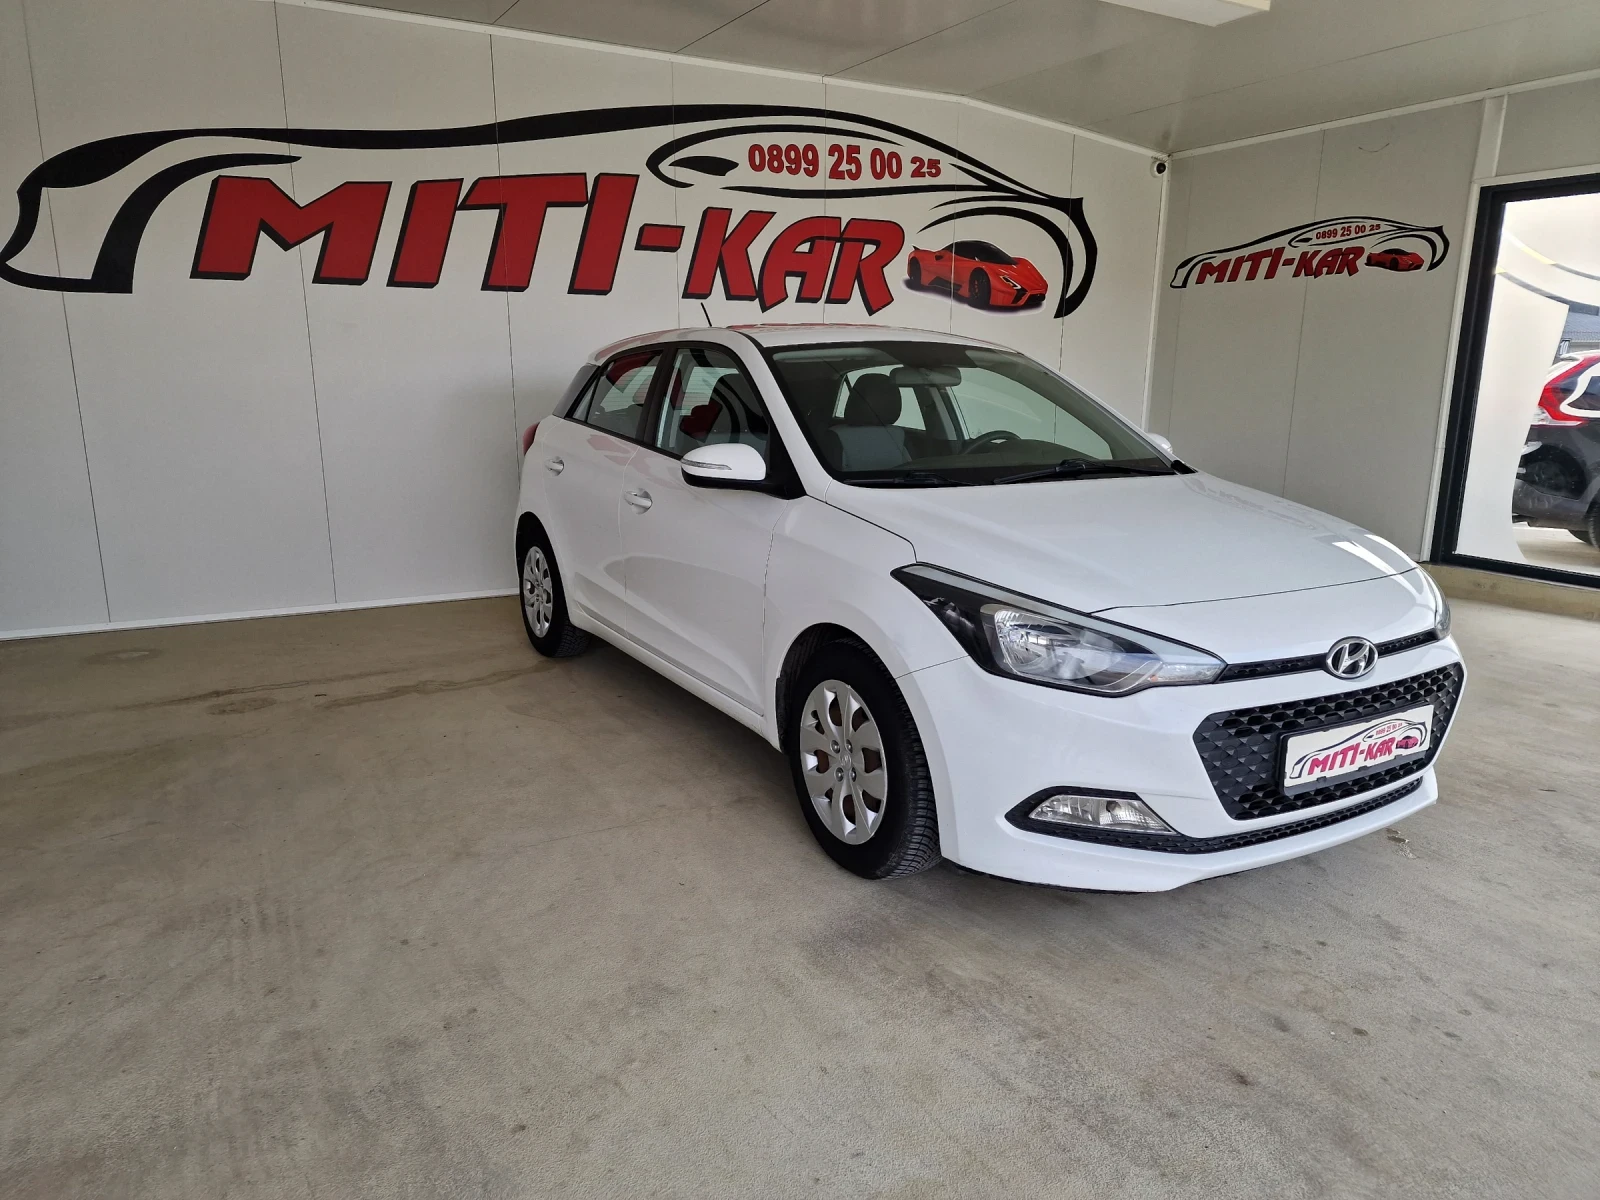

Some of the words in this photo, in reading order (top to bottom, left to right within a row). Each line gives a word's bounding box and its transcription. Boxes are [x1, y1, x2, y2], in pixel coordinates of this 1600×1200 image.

[748, 144, 820, 178] 0899
[828, 144, 862, 181] 25
[870, 148, 903, 180] 00
[910, 156, 942, 178] 25
[189, 172, 905, 316] MITI-KAR
[1315, 228, 1338, 240] 0899
[1340, 226, 1352, 237] 25
[1354, 225, 1367, 235] 00
[1369, 224, 1381, 232] 25
[1195, 246, 1365, 284] MITI-KAR
[1308, 737, 1396, 775] MITI-KAR
